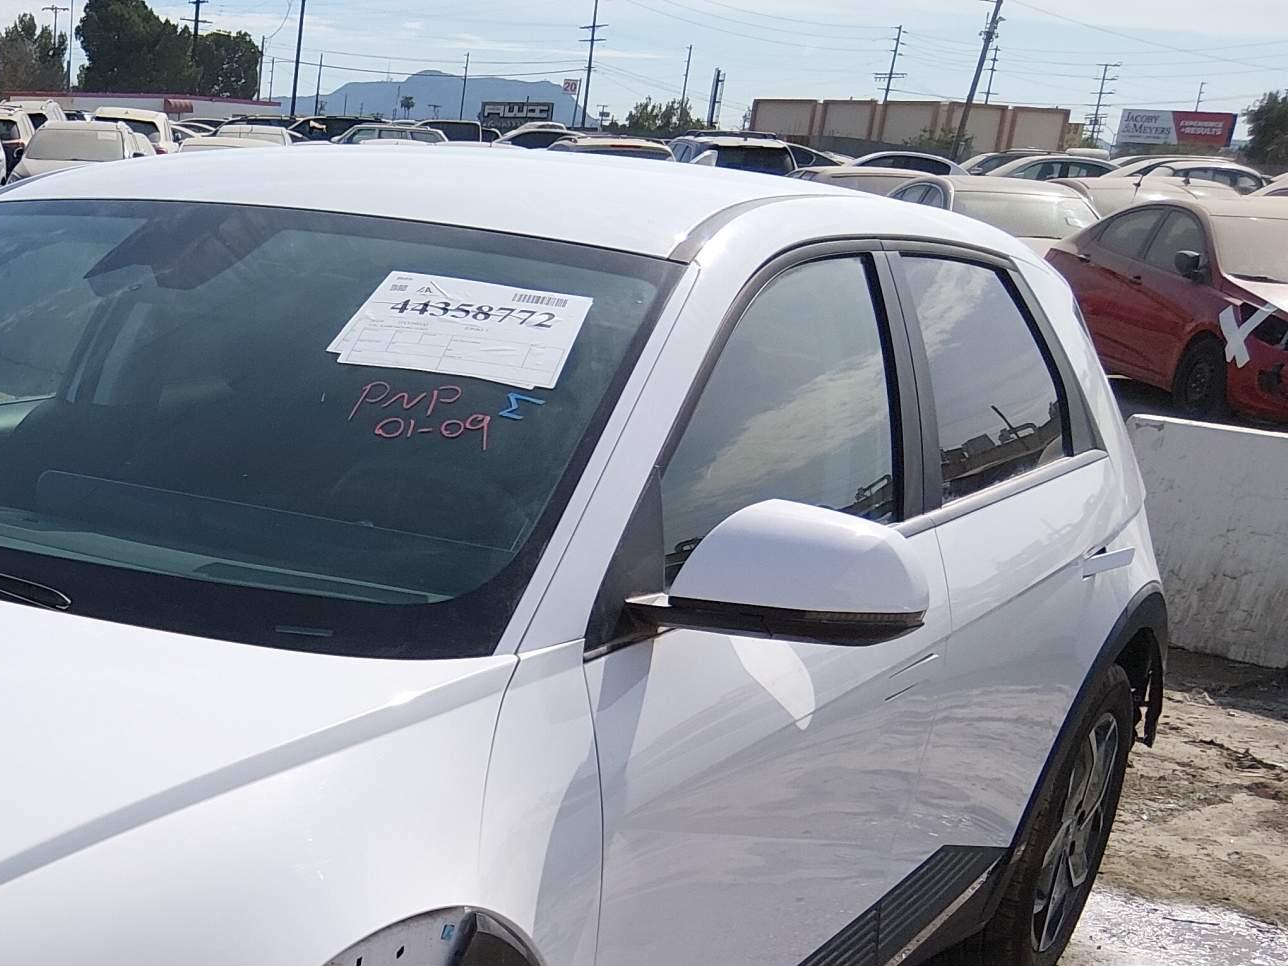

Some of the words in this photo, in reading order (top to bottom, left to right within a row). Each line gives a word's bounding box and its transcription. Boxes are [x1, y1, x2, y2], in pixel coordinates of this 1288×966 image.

[390, 298, 556, 329] 44358772
[347, 381, 462, 421] PNP
[374, 413, 491, 450] 01-09
